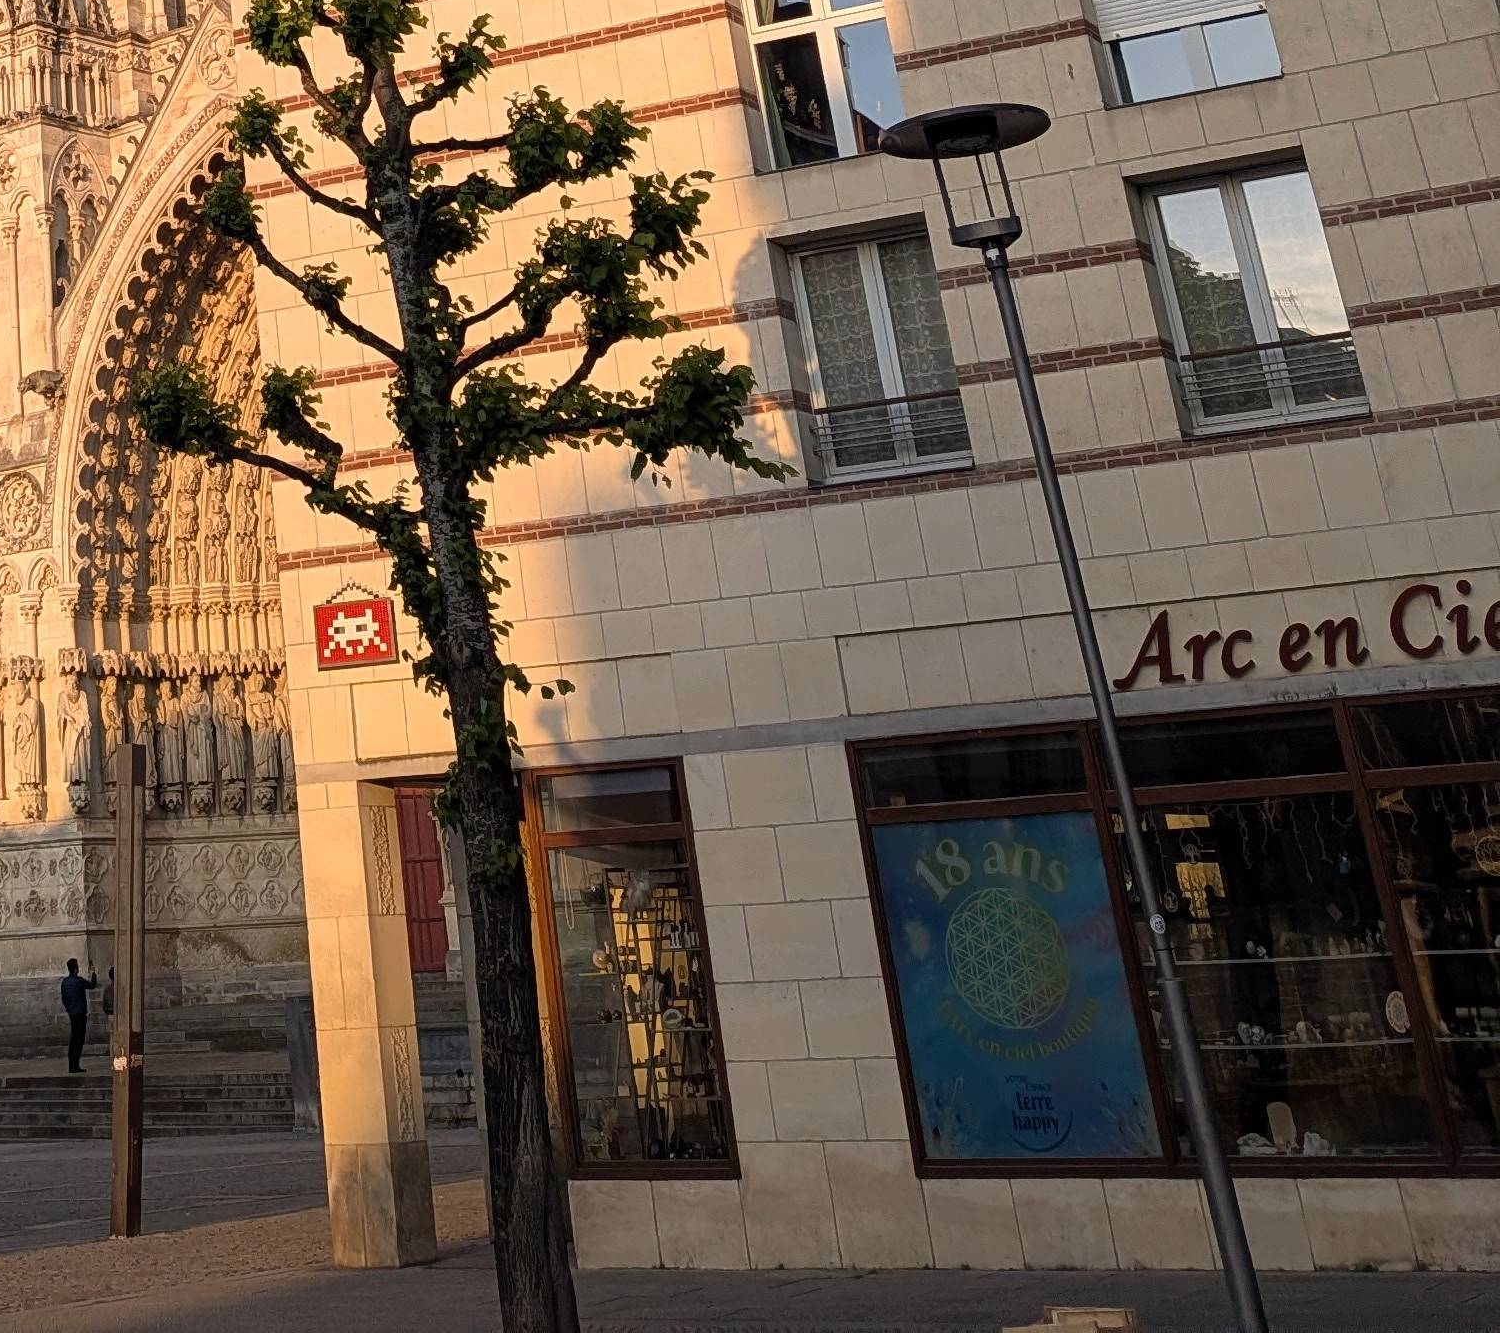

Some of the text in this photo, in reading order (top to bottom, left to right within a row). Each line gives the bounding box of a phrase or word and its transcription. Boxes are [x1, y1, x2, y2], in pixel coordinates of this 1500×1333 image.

[1112, 609, 1256, 690] Arc
[1278, 615, 1370, 673] en
[915, 837, 1068, 903] 18 ans
[1011, 1109, 1060, 1135] happy
[1015, 1091, 1055, 1111] terre
